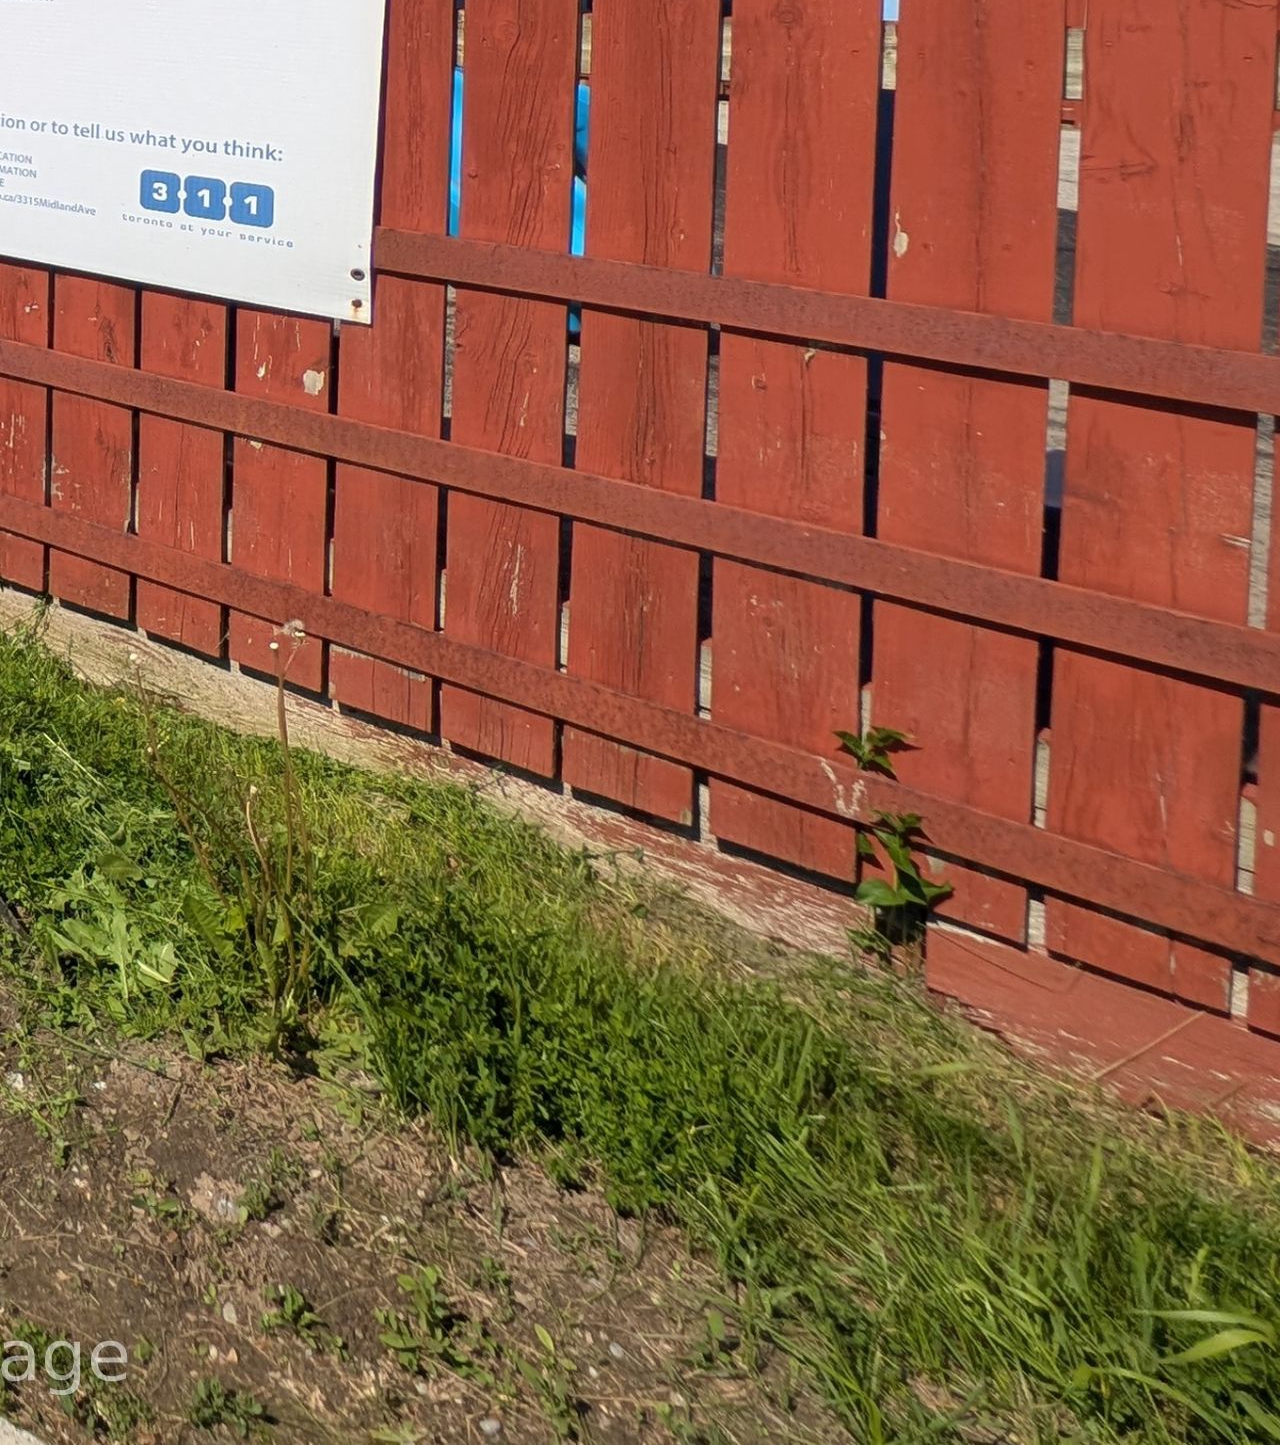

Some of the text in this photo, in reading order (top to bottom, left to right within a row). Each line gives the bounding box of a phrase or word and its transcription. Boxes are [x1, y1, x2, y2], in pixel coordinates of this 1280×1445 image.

[30, 120, 48, 132] or
[51, 121, 69, 135] to
[73, 122, 100, 139] tell
[105, 128, 125, 142] us
[129, 130, 177, 149] what
[181, 138, 218, 155] you
[223, 139, 284, 162] think:
[121, 213, 294, 249] toronto at your service
